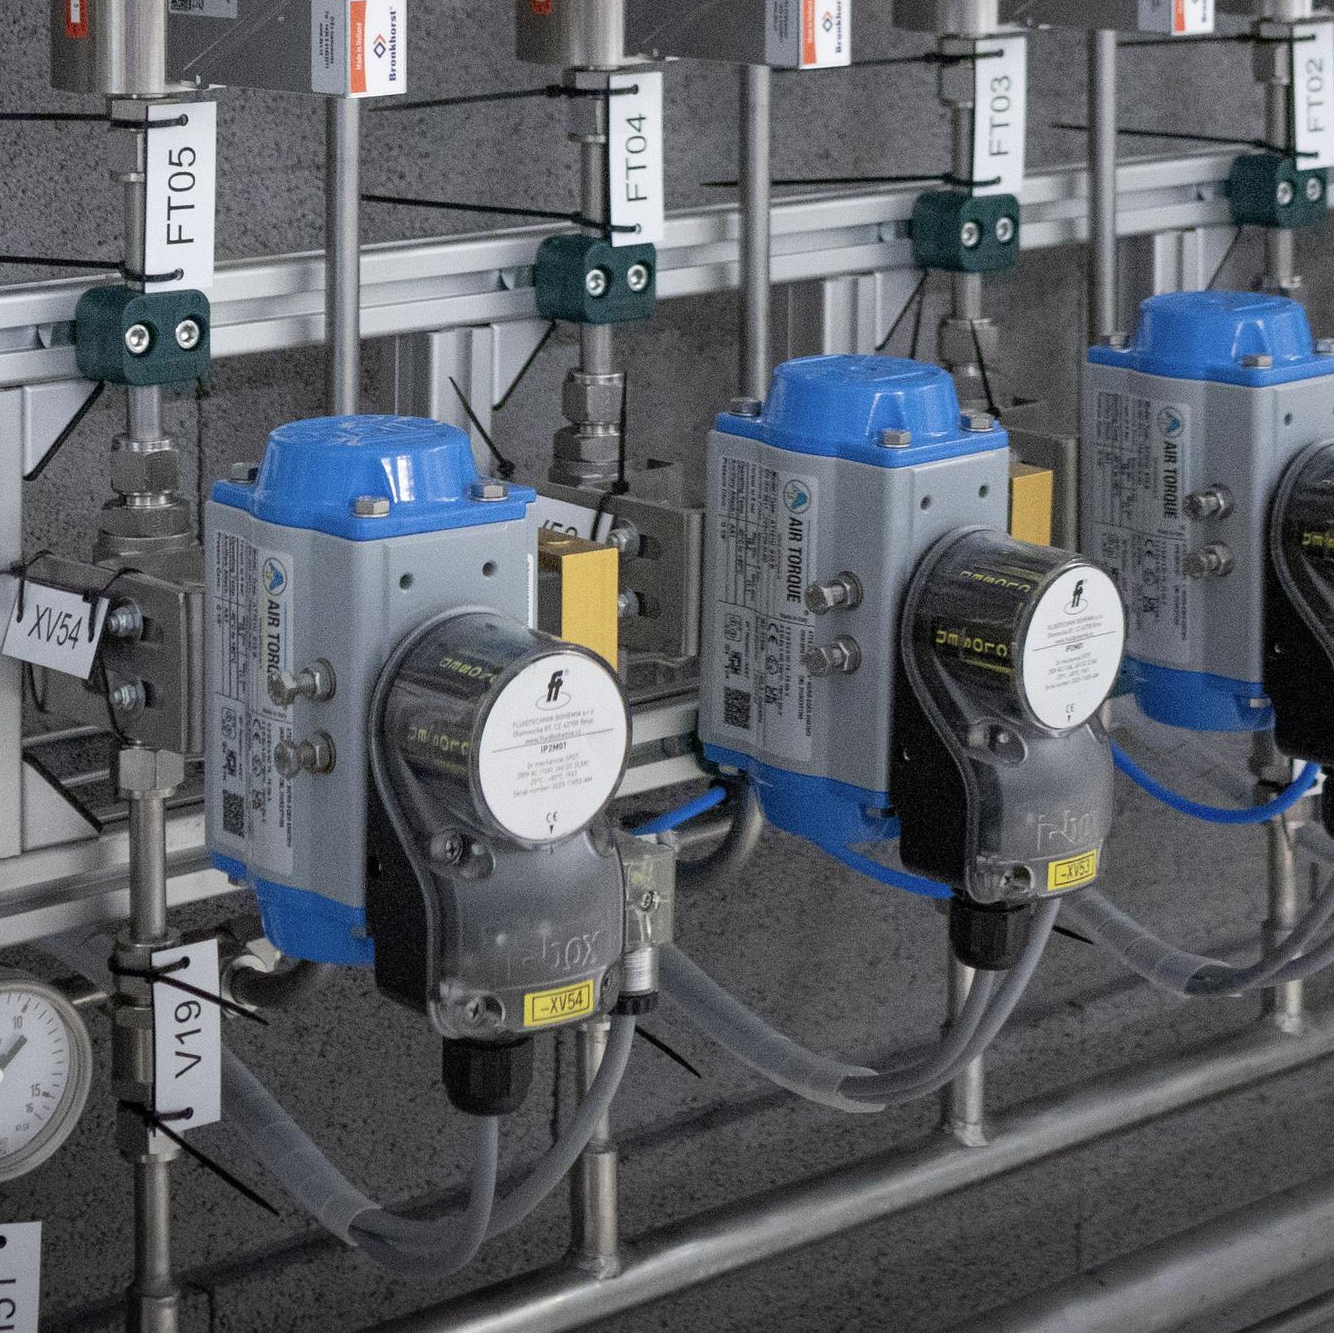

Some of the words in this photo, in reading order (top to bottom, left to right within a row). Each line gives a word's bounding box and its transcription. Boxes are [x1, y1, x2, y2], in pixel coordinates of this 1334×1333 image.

[389, 10, 397, 82] Bronkhorst
[988, 73, 1013, 160] FT03
[1306, 56, 1327, 136] FT02
[625, 111, 648, 204] FT04
[165, 145, 198, 247] FT05
[1164, 441, 1178, 463] AIR
[1164, 468, 1178, 519] TORQUE
[788, 517, 803, 541] AIR
[787, 546, 802, 603] TORQUE
[25, 599, 86, 651] XV54
[267, 599, 280, 627] AIR
[267, 634, 280, 673] TORQ
[540, 742, 567, 753] IP2M01
[1060, 858, 1090, 882] -XV53
[12, 1016, 22, 1029] 10
[540, 990, 583, 1014] -XV54
[173, 996, 204, 1081] V19
[31, 1084, 40, 1097] 15
